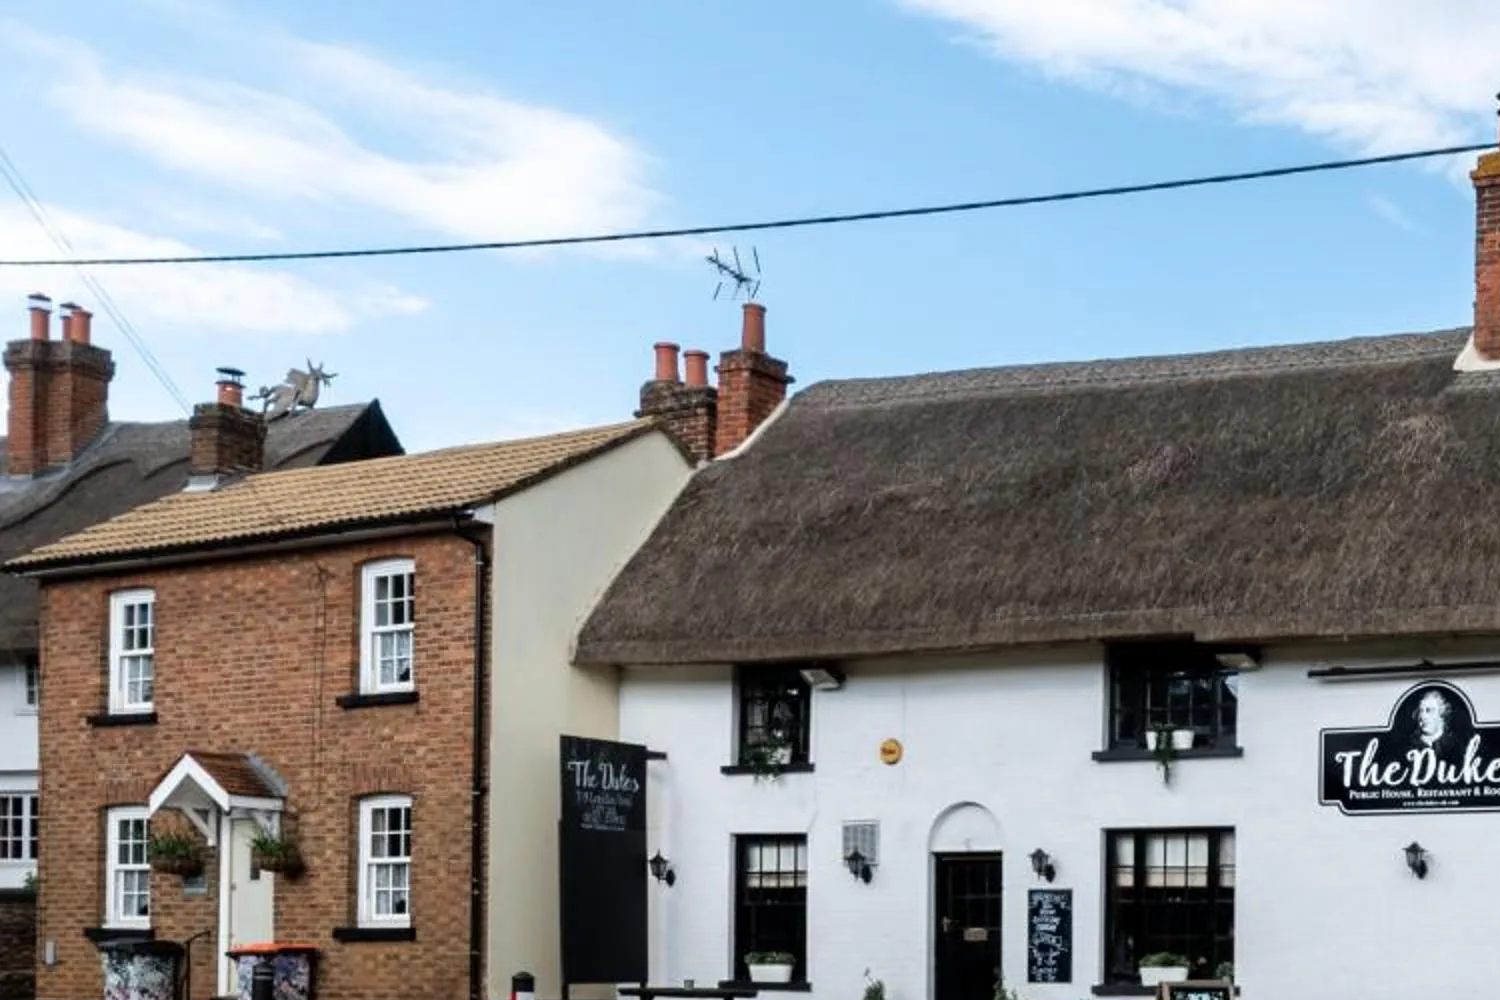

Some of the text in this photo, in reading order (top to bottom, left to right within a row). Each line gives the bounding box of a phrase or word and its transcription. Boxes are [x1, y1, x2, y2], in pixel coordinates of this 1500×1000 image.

[567, 759, 640, 793] The Dukes
[1335, 738, 1408, 787] The
